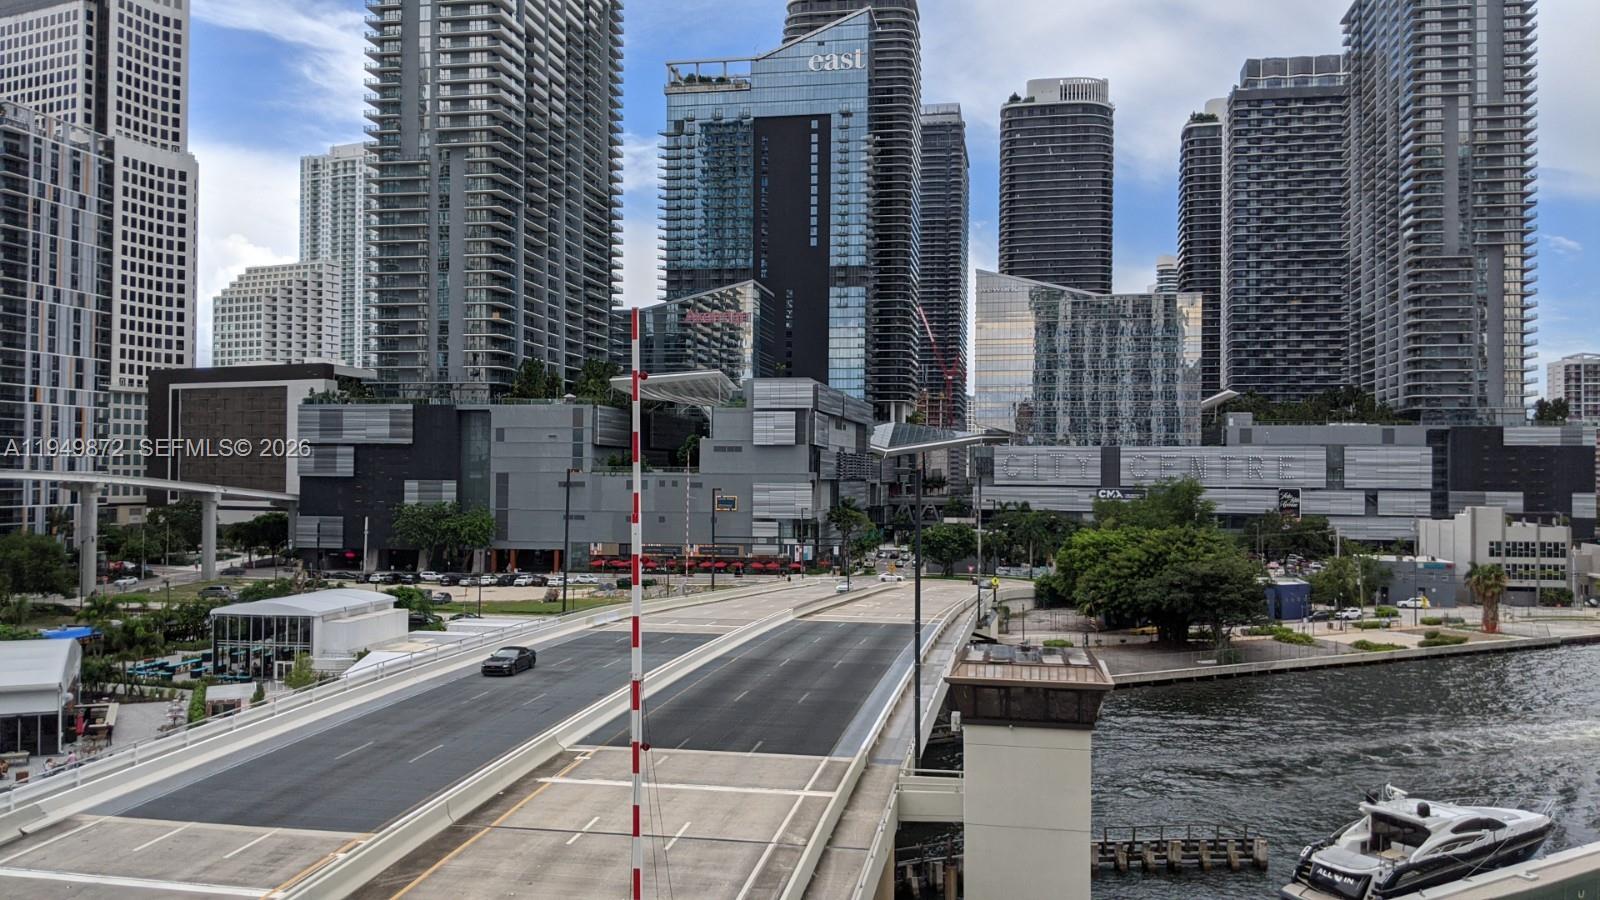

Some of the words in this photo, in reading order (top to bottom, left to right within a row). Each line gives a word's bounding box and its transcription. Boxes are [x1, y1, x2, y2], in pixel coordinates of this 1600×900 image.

[808, 48, 866, 71] east
[1002, 453, 1092, 477] CITY
[1129, 453, 1295, 479] CENTRE
[1317, 868, 1333, 879] ALL
[1343, 877, 1354, 885] IN
